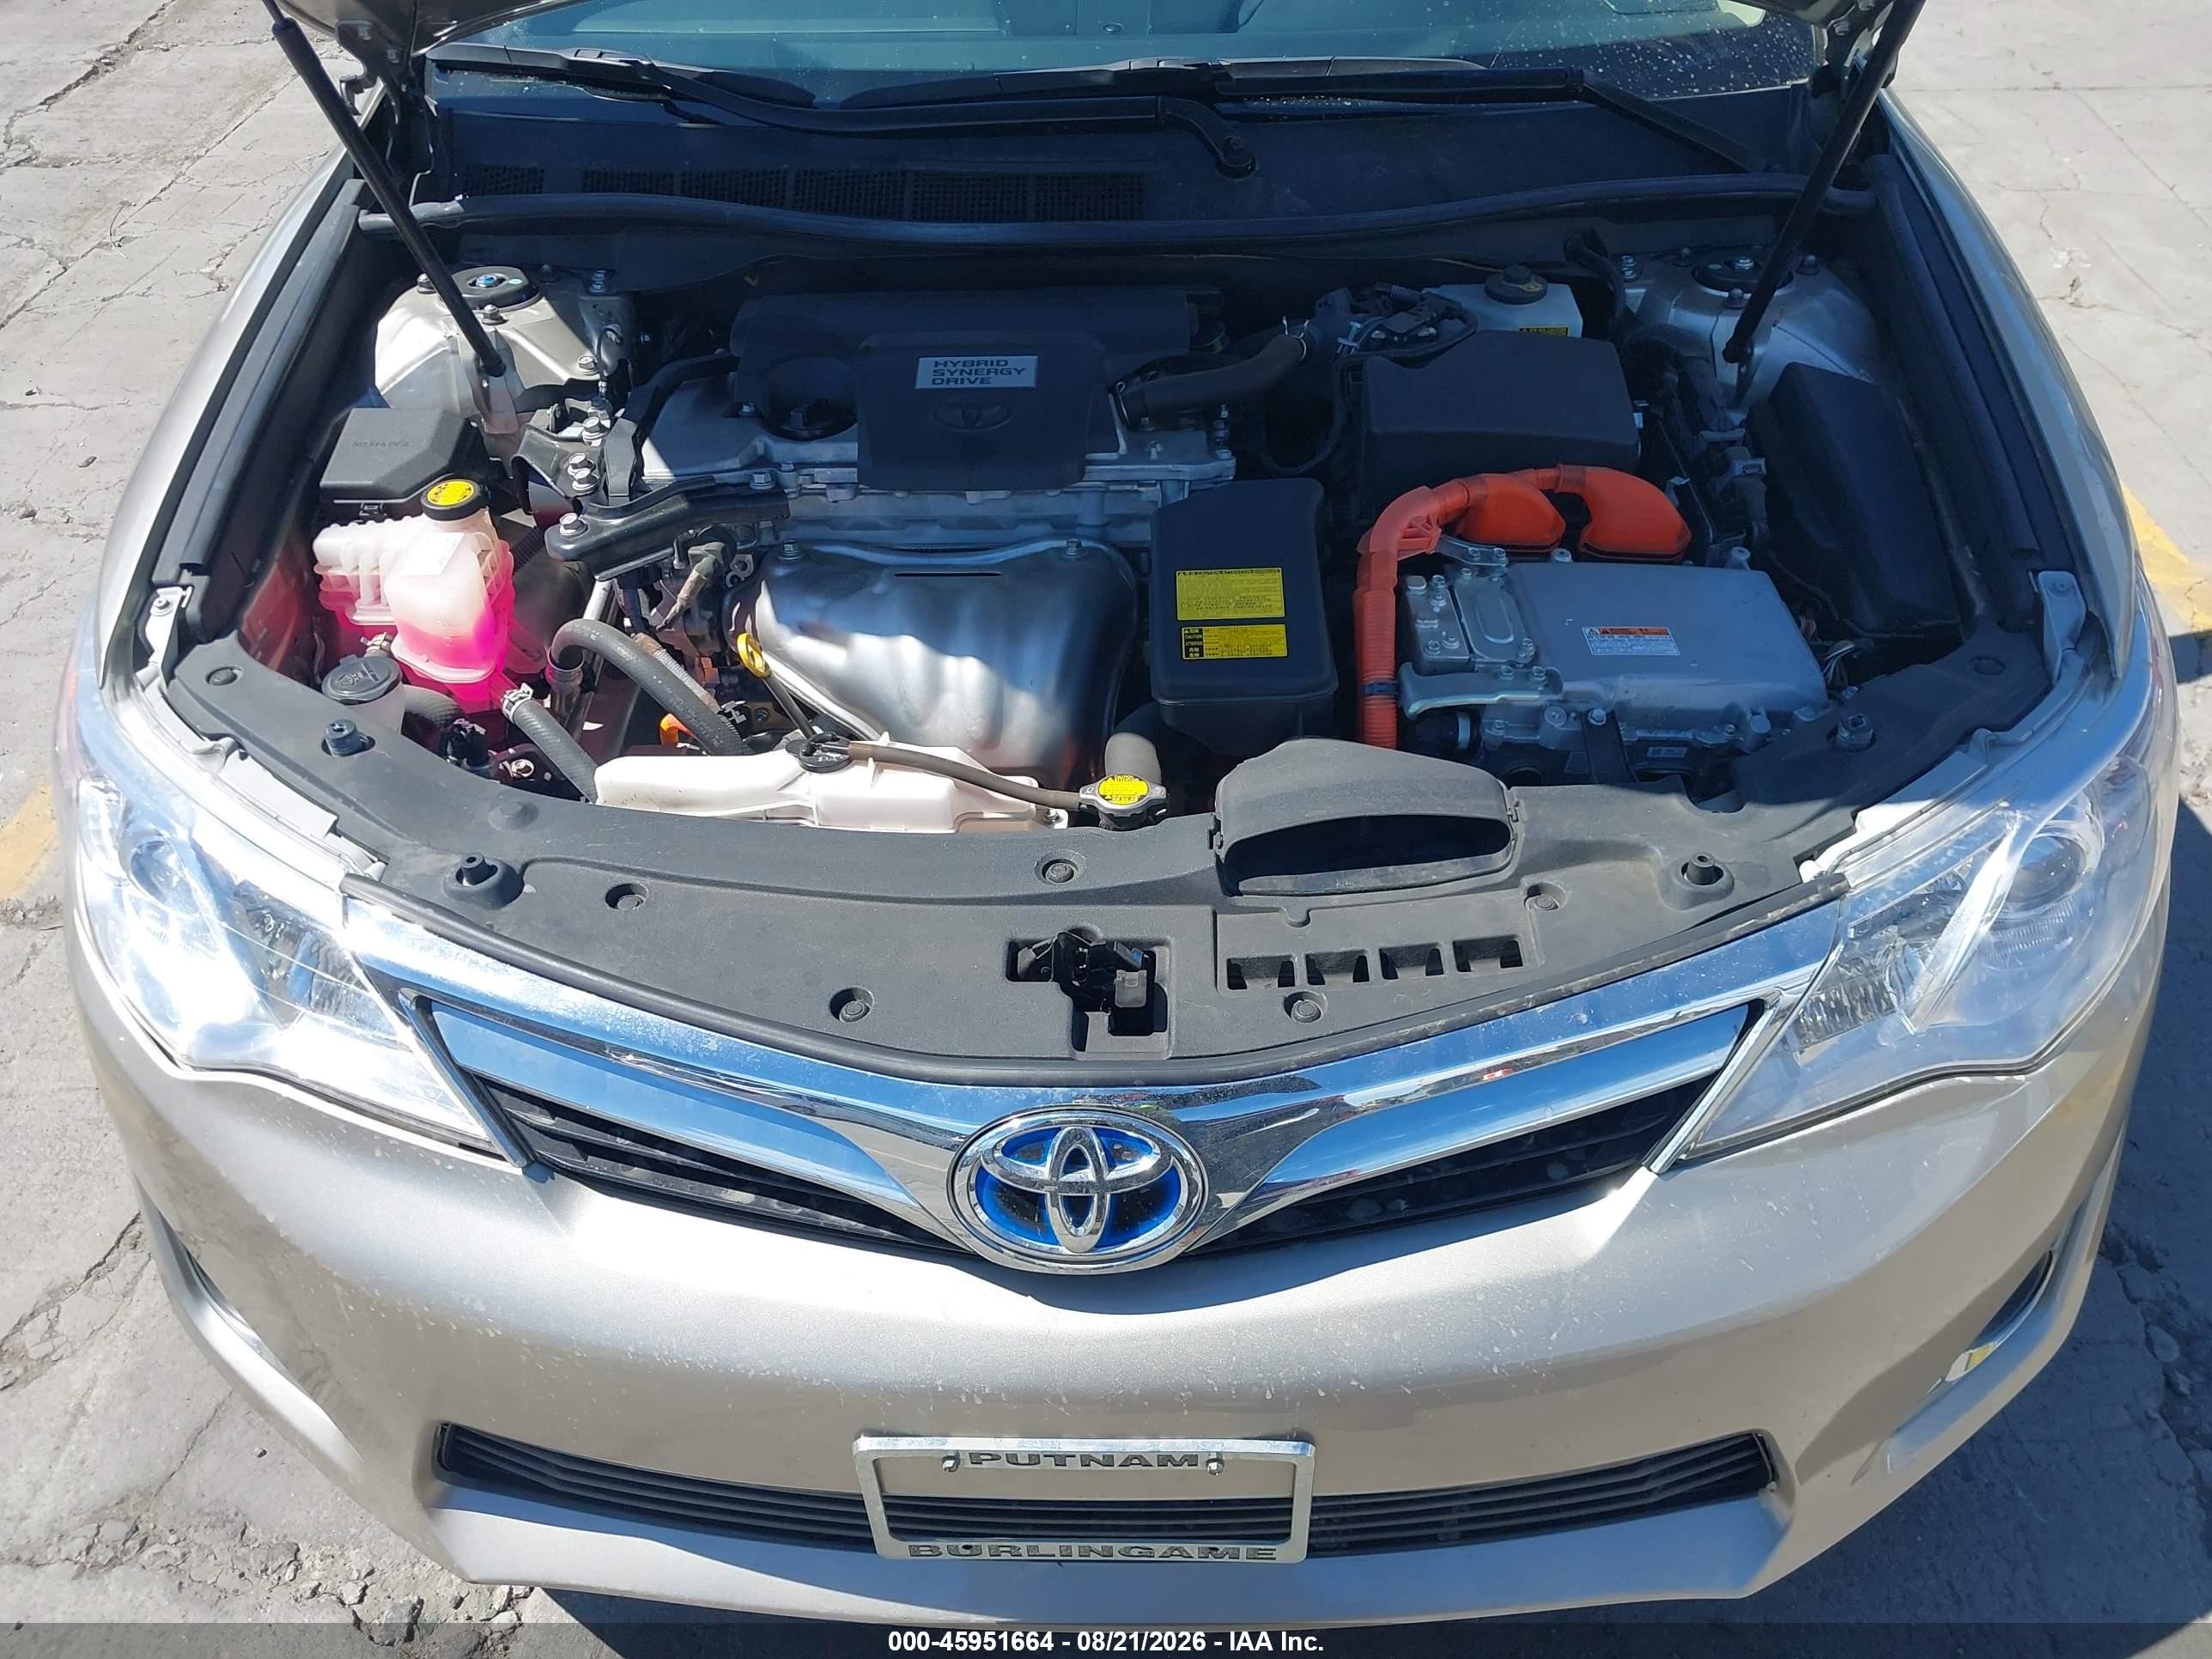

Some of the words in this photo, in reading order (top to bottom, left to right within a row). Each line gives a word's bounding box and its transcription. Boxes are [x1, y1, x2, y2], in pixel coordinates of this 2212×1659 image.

[933, 359, 1009, 368] HYBRID
[932, 368, 1026, 377] SYNERGY
[931, 377, 993, 386] DRIVE
[969, 1451, 1199, 1468] PUTNAM
[908, 1544, 1277, 1560] BURLINGAME
